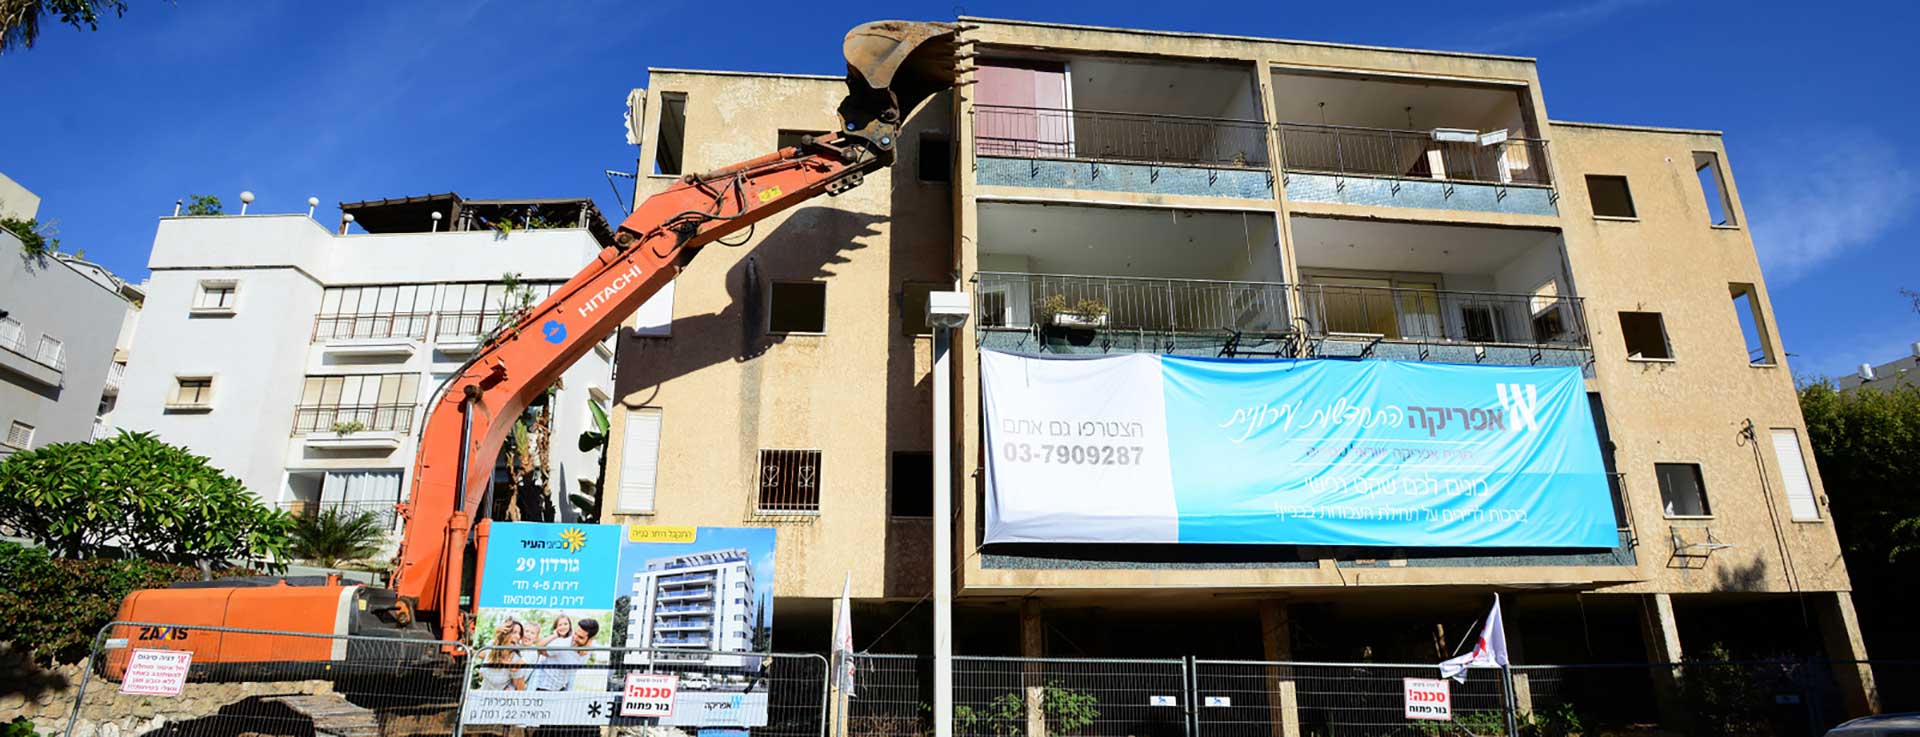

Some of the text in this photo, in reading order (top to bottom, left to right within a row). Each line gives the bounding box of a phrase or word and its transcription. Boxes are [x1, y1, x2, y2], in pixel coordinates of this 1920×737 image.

[578, 264, 642, 318] HITACHI
[1299, 396, 1403, 430] התחדשות
[1002, 418, 1144, 438] הצטרפו גם אתם
[1218, 398, 1304, 444] עירונית
[1407, 405, 1506, 437] אפריקה
[1003, 442, 1144, 466] 03-7909287
[1403, 472, 1438, 496] לכם
[520, 540, 545, 548] העיר
[515, 556, 580, 576] גורדון 29
[532, 580, 550, 591] 4-5
[552, 580, 579, 591] דירות
[560, 596, 584, 605] דירת
[138, 626, 189, 641] ZAXIS
[629, 685, 671, 698] סכנה!
[1409, 689, 1446, 702] סכנה!
[626, 702, 669, 711] בור פתוח
[1409, 705, 1447, 714] בור פתוח
